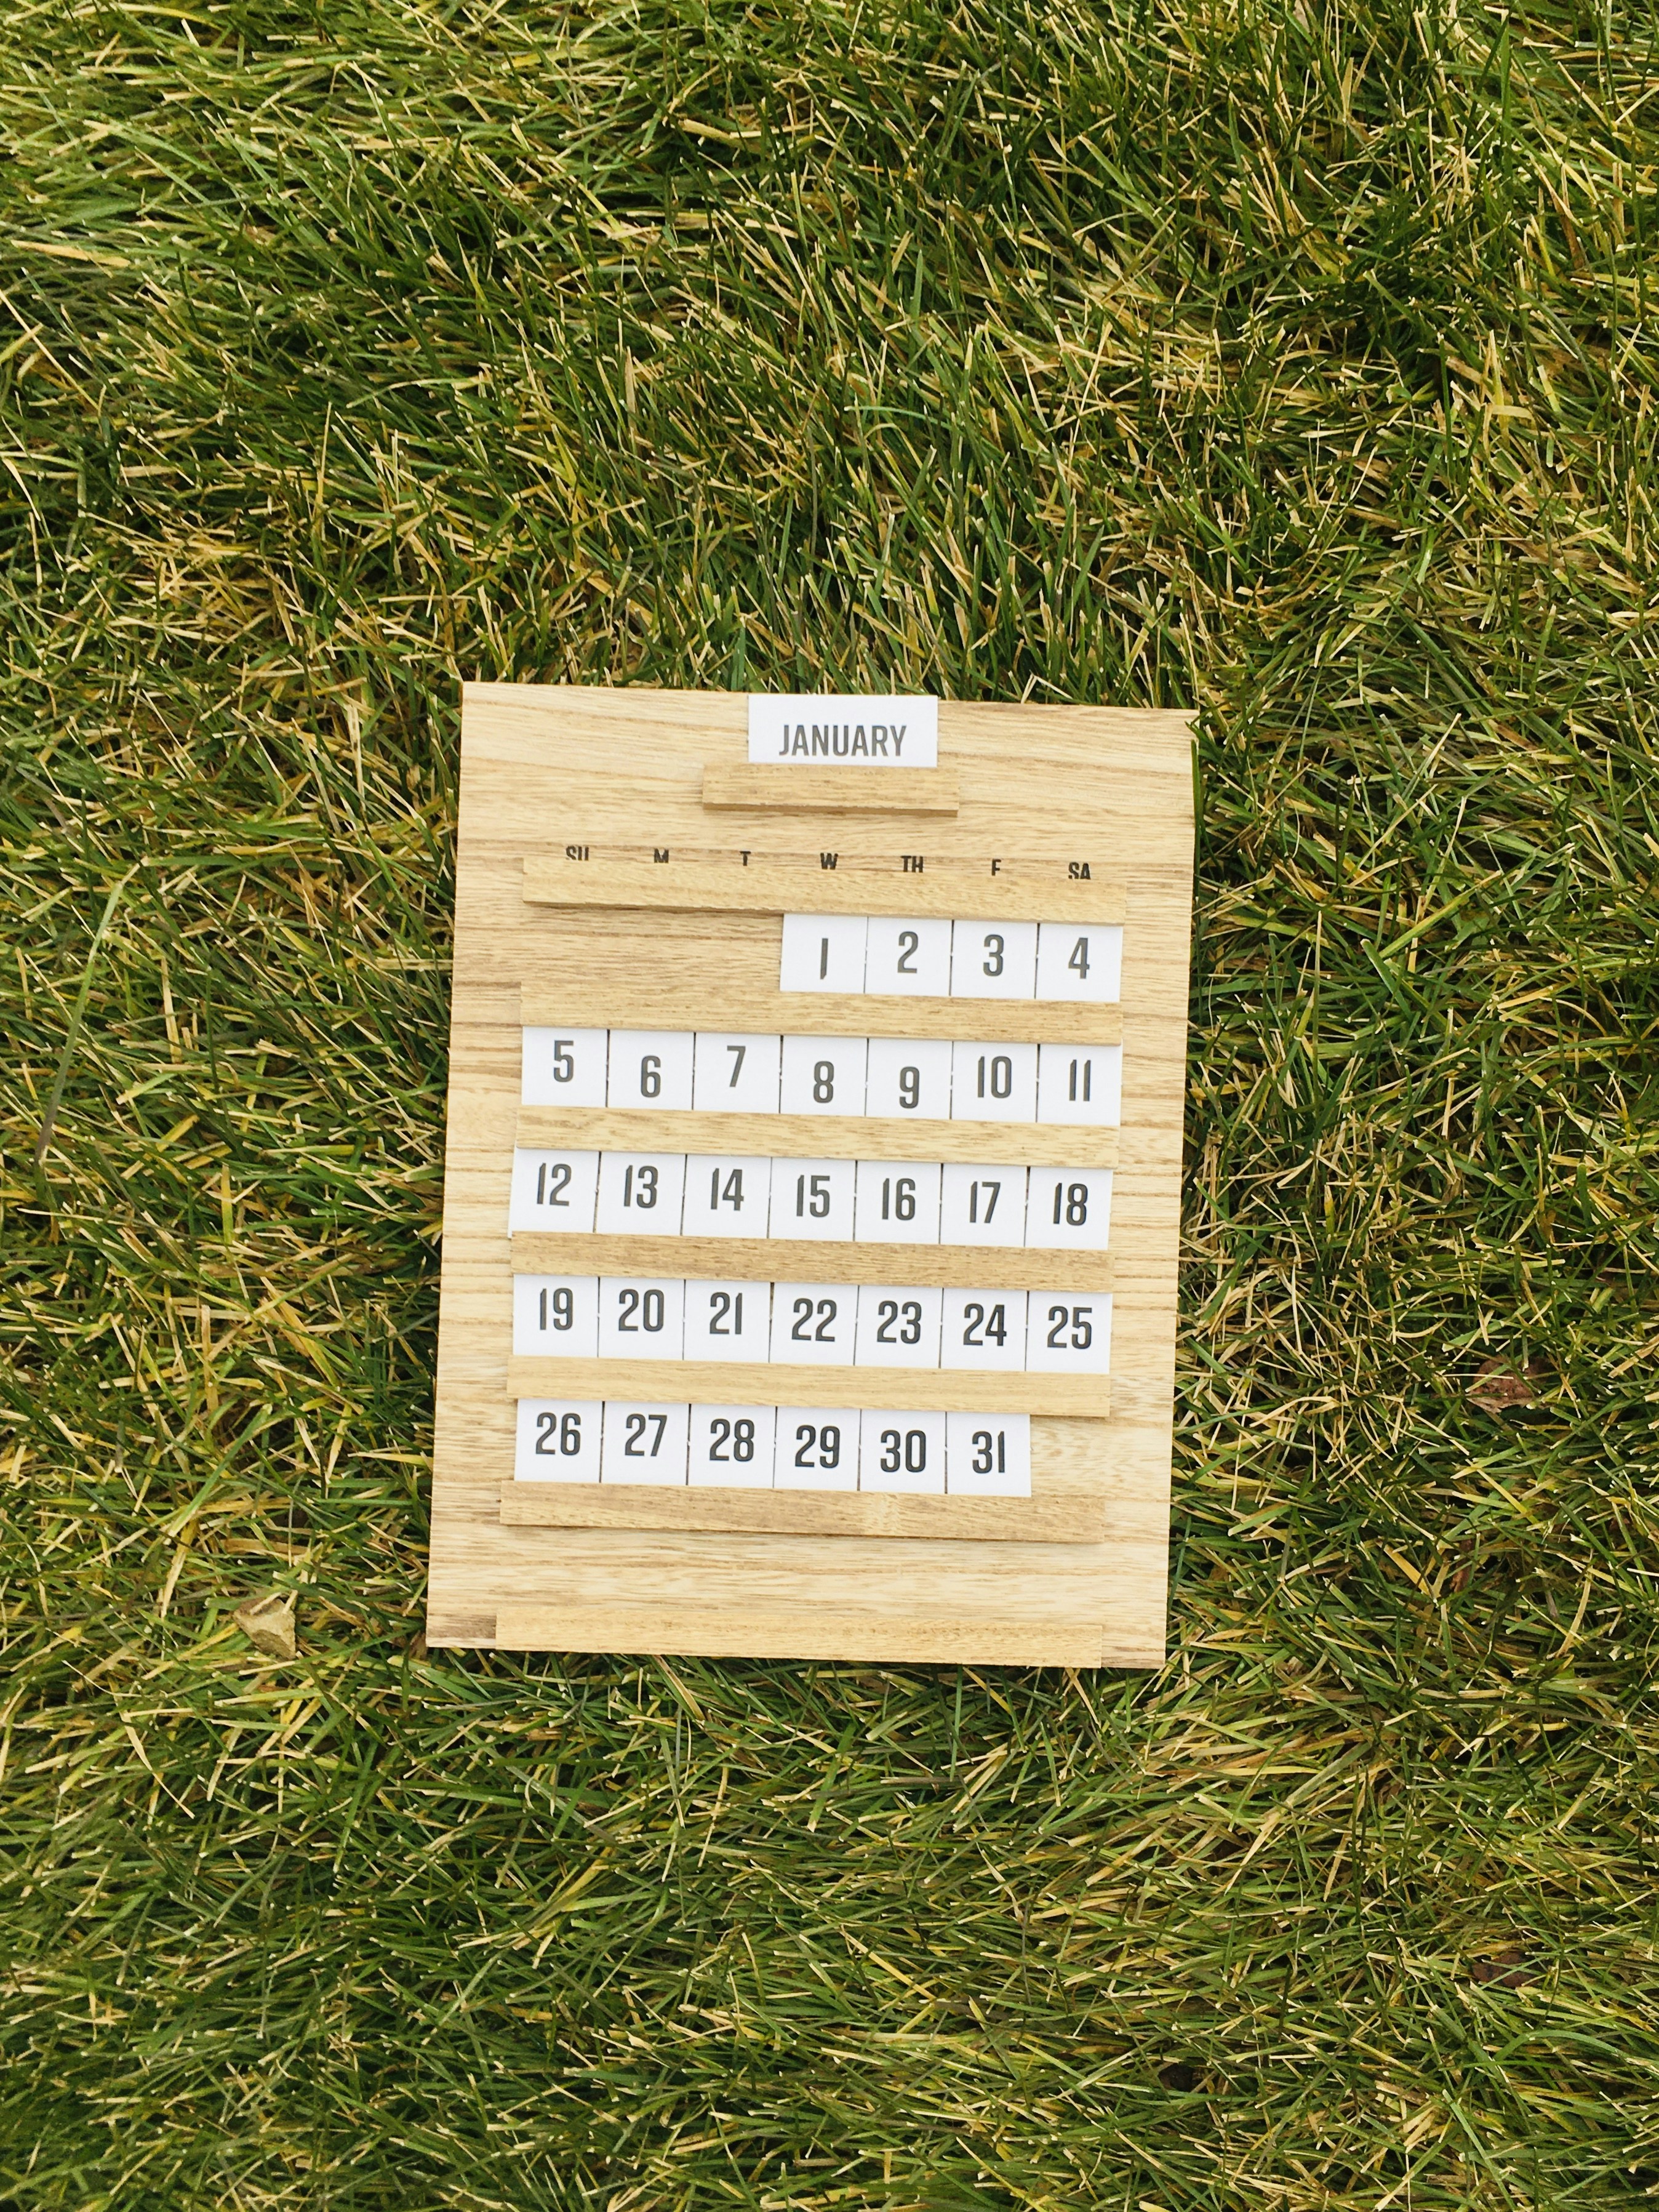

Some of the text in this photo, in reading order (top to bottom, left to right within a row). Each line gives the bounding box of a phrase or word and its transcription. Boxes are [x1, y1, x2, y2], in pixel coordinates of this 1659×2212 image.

[779, 725, 906, 756] JANUARY
[654, 849, 669, 863] M
[740, 851, 751, 866] T
[820, 853, 839, 870] W
[901, 856, 924, 873] TH
[991, 859, 1001, 876] F
[1068, 862, 1090, 880] SA
[820, 931, 1090, 979] 1 2 3 4
[553, 1040, 1091, 1109] 5 6 7 8 9 10 11
[537, 1163, 1088, 1226] 12 13 14 15 16 17 18
[540, 1288, 1092, 1350] 19 20 21 22 23 24 25
[535, 1412, 1005, 1474] 26 27 28 29 30 31
